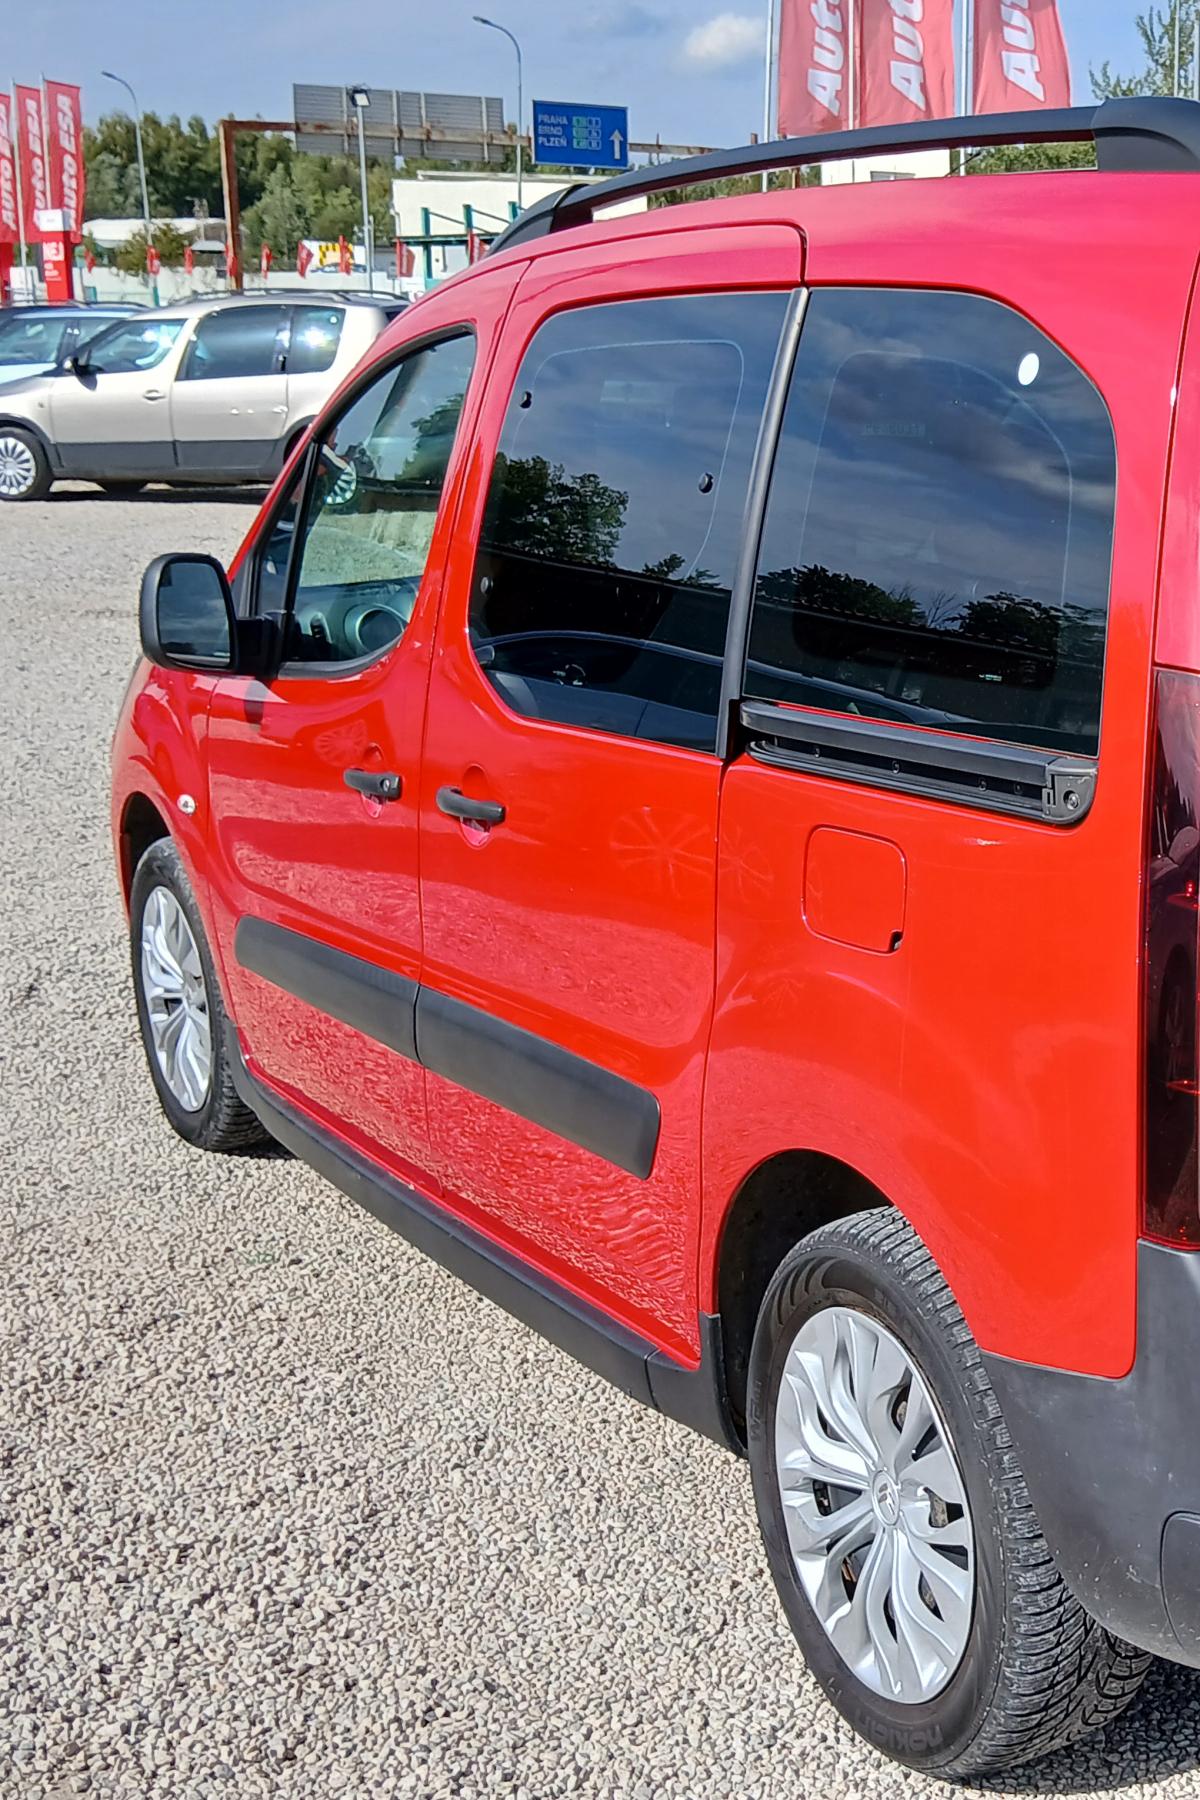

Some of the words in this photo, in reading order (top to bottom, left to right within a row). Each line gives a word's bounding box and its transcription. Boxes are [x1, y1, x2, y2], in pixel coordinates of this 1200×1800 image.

[807, 0, 844, 117] Aut
[56, 93, 77, 154] ESA
[538, 114, 568, 125] PRAHA
